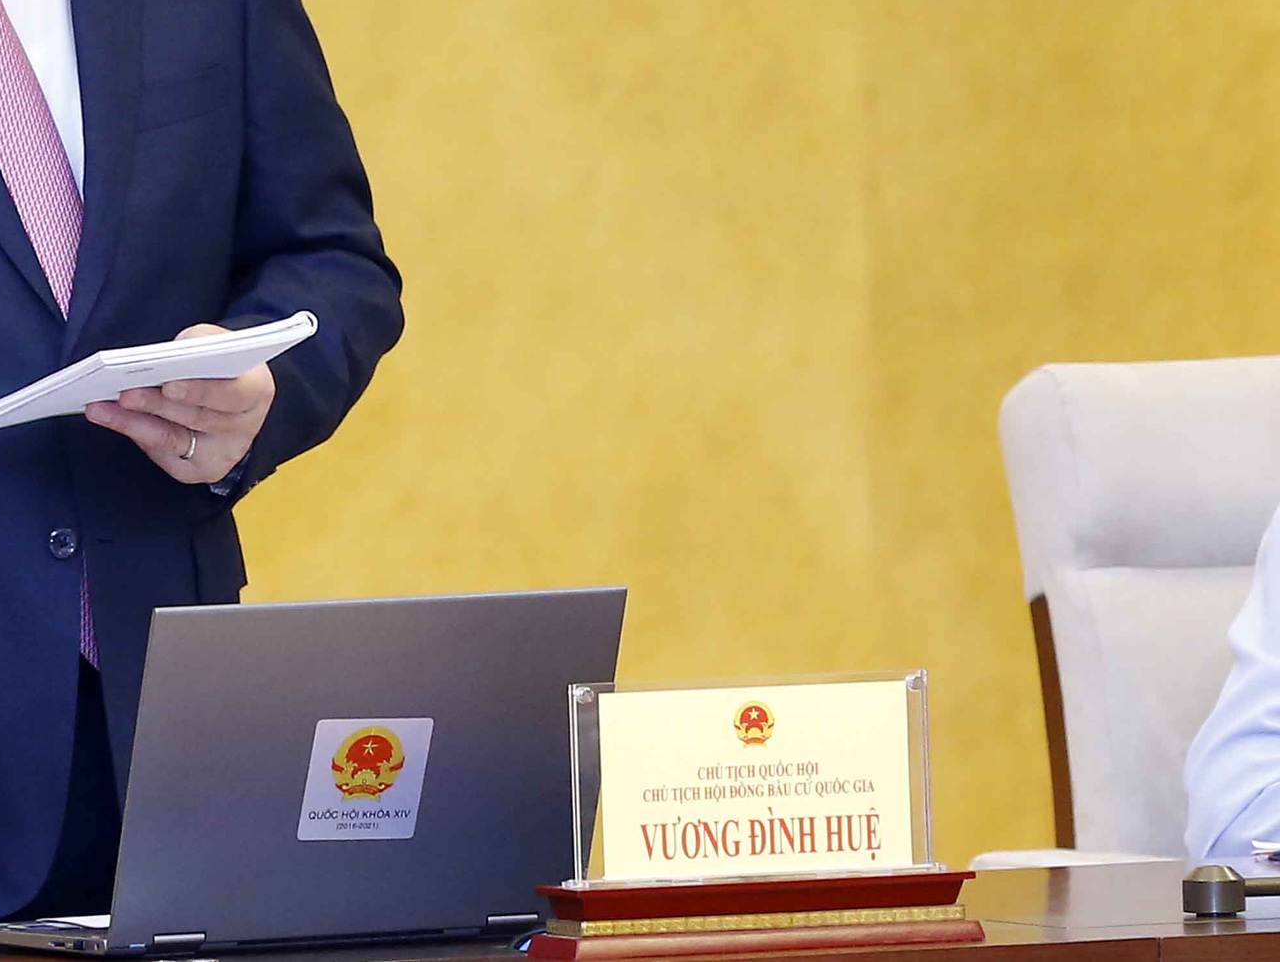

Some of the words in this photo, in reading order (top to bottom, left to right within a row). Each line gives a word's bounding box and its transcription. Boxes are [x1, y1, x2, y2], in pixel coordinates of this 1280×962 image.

[697, 762, 723, 780] CHỦ
[725, 765, 756, 782] TỊCH
[758, 760, 794, 780] QUỐC
[796, 760, 819, 779] HỘI
[643, 784, 669, 802] CHỦ
[671, 787, 701, 804] TỊCH
[704, 784, 727, 802] HỘI
[729, 781, 765, 799] ĐỒNG
[815, 777, 851, 798] QUỐC
[853, 779, 875, 794] GIA
[341, 809, 360, 820] HỘI
[393, 809, 411, 818] XIV
[640, 816, 742, 862] VƯƠNG
[747, 806, 818, 857] ĐÌNH
[824, 807, 882, 862] HUỆ
